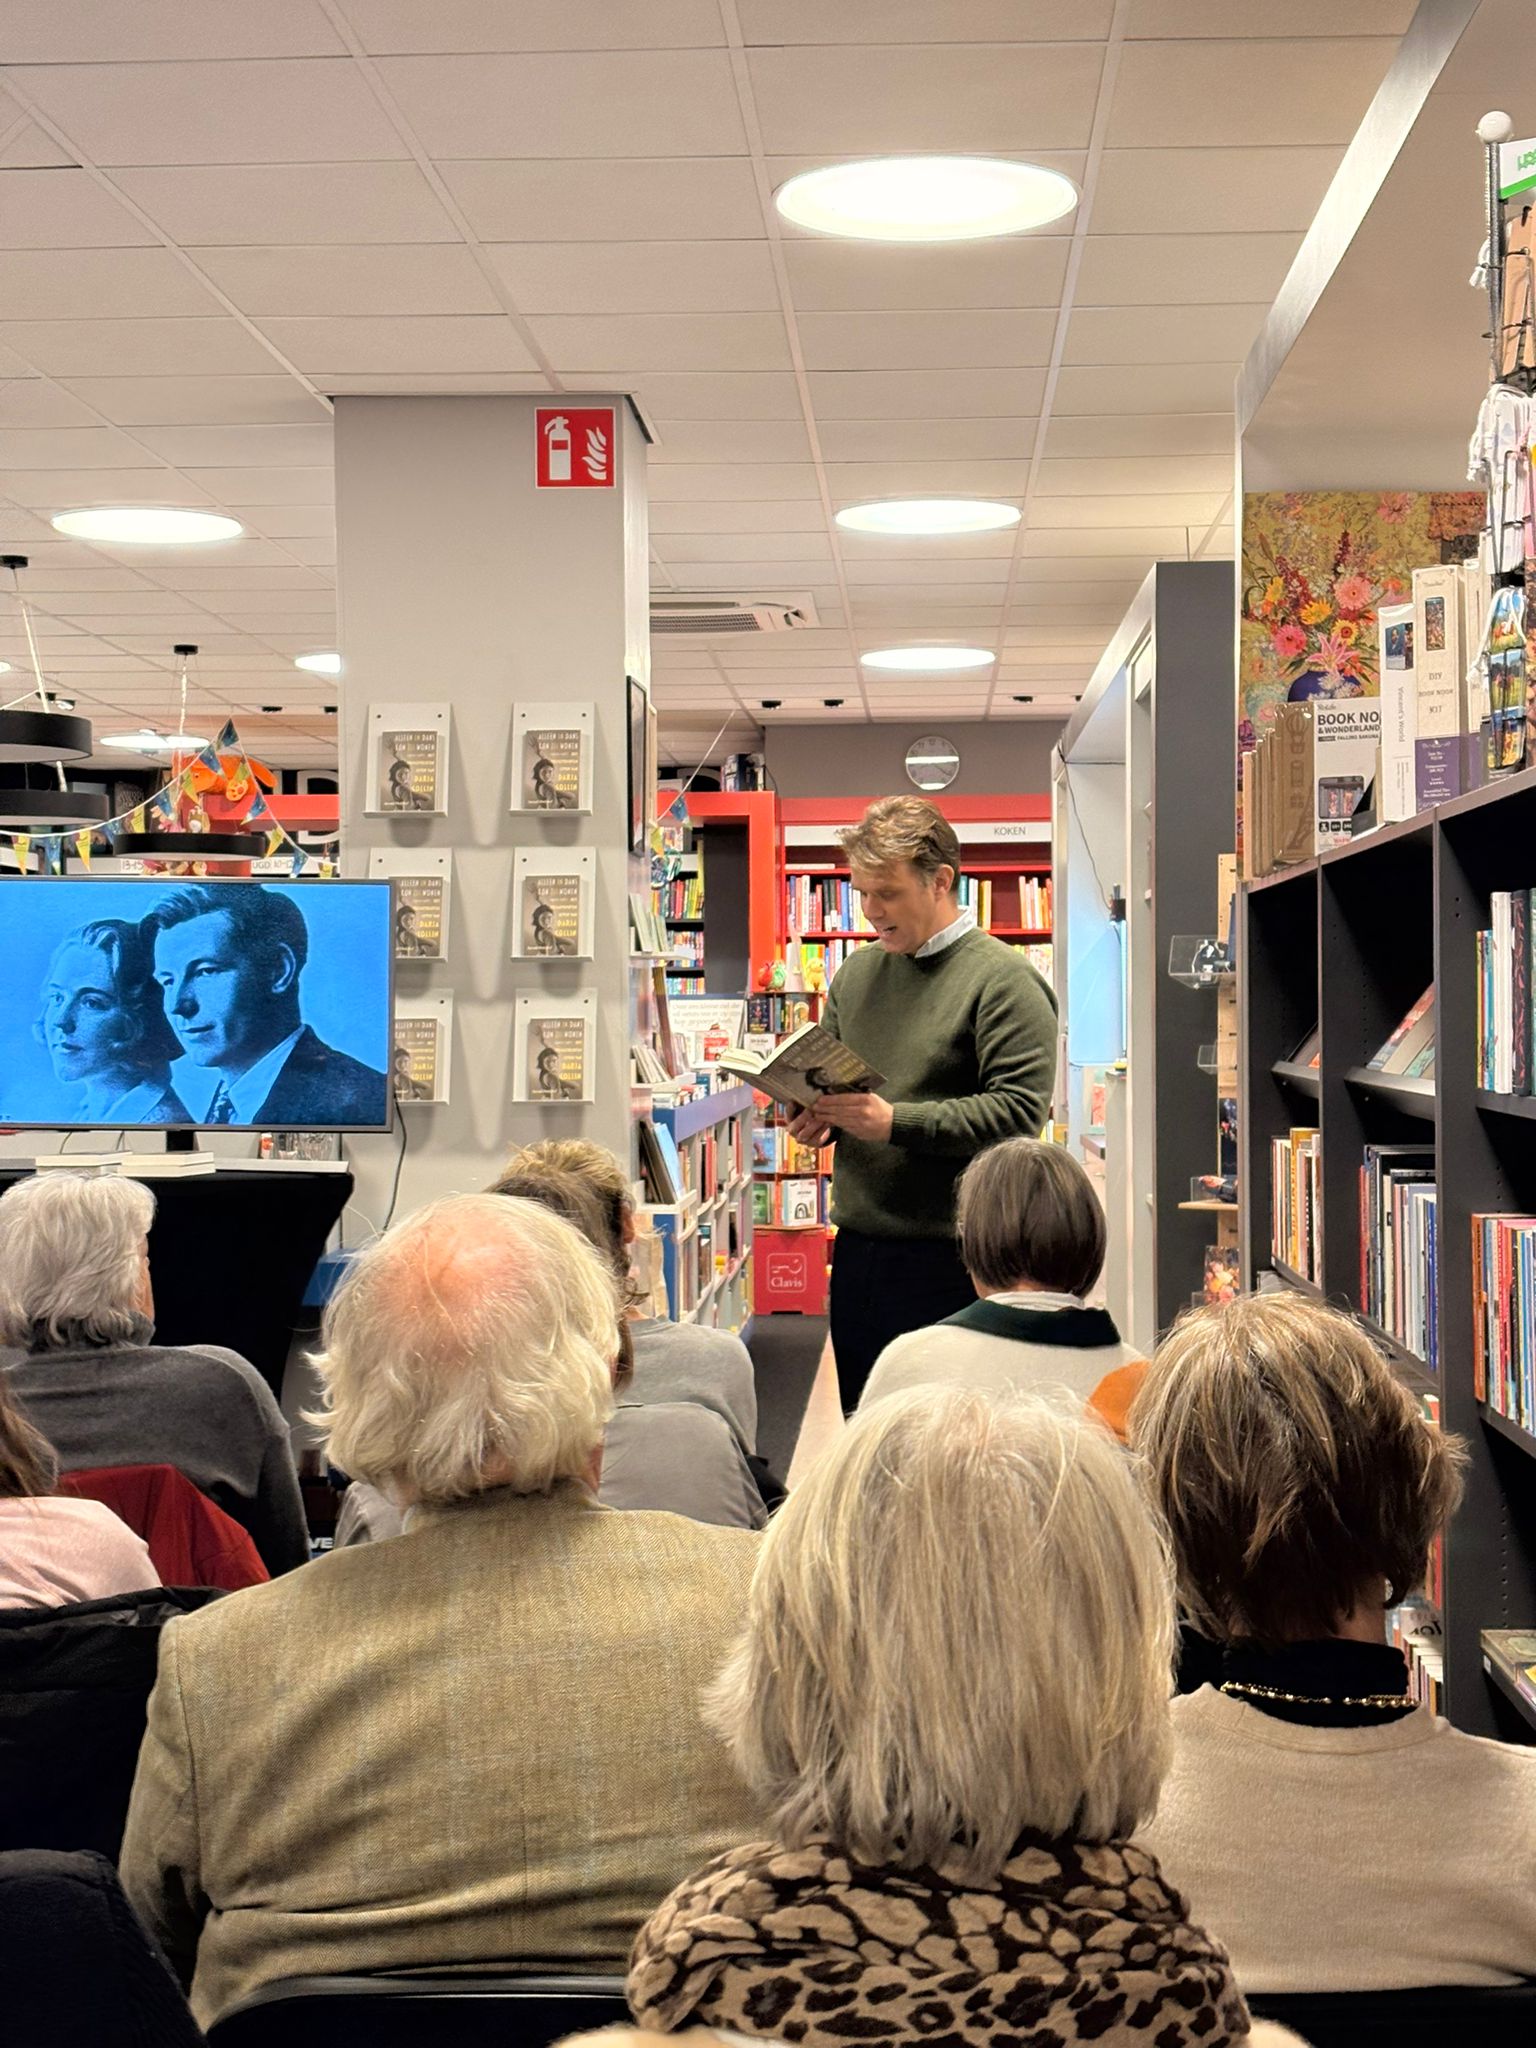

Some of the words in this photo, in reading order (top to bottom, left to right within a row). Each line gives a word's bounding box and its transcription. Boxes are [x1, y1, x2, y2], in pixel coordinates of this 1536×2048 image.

[1318, 712, 1356, 726] BOOK
[1360, 711, 1379, 723] NO
[994, 826, 1026, 836] KOKEN
[771, 1277, 802, 1288] Clavis
